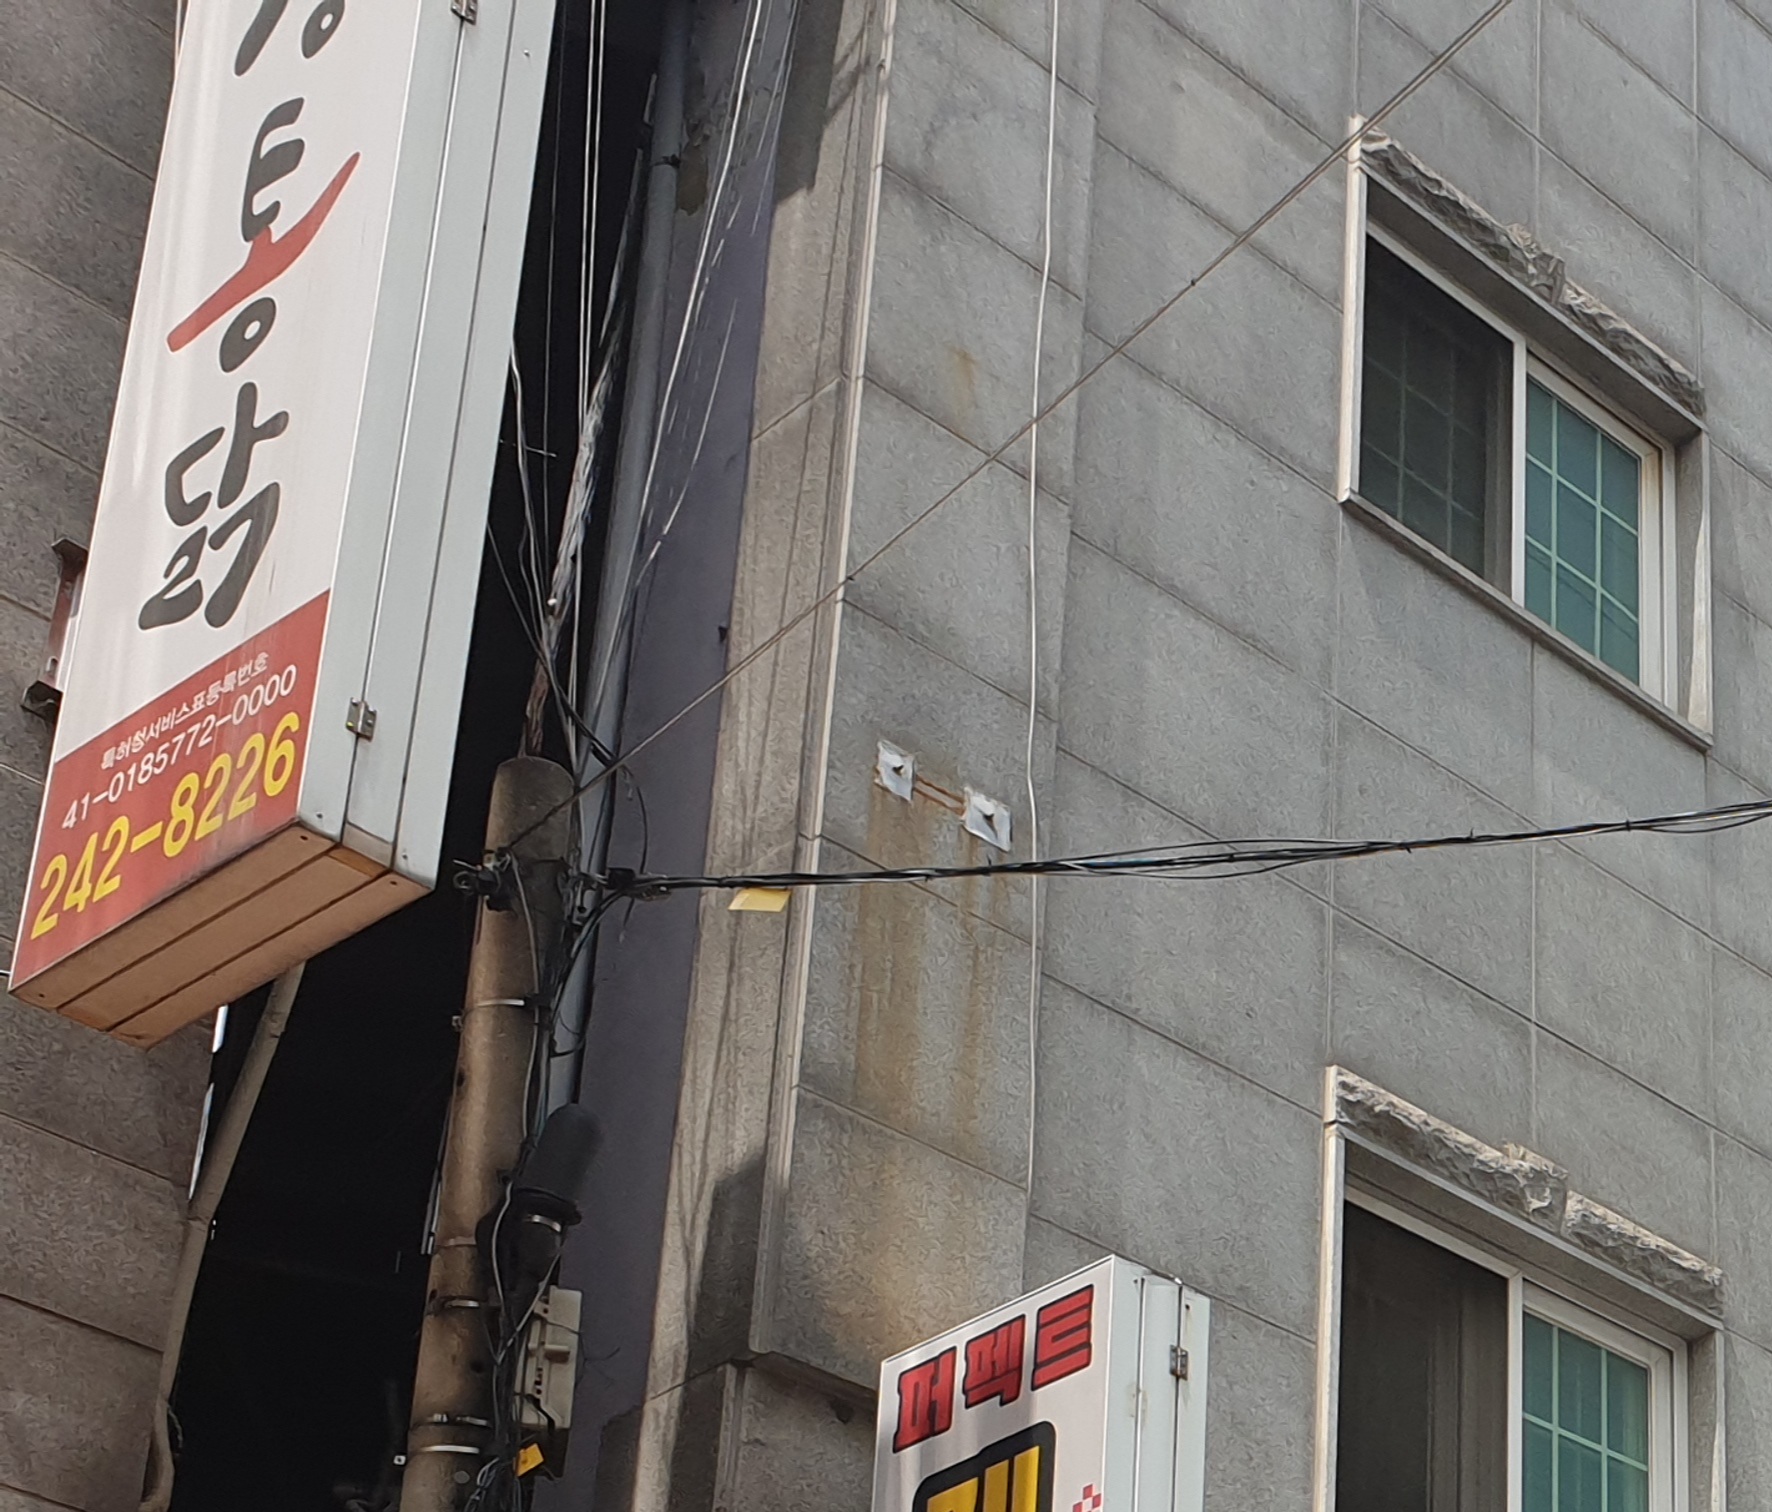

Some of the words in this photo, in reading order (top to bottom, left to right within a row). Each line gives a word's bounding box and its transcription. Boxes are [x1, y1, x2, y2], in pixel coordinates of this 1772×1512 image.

[30, 711, 300, 940] 242-8226
[62, 664, 297, 829] 41-0185772-0000
[892, 1284, 1094, 1454] 퍼펙트
